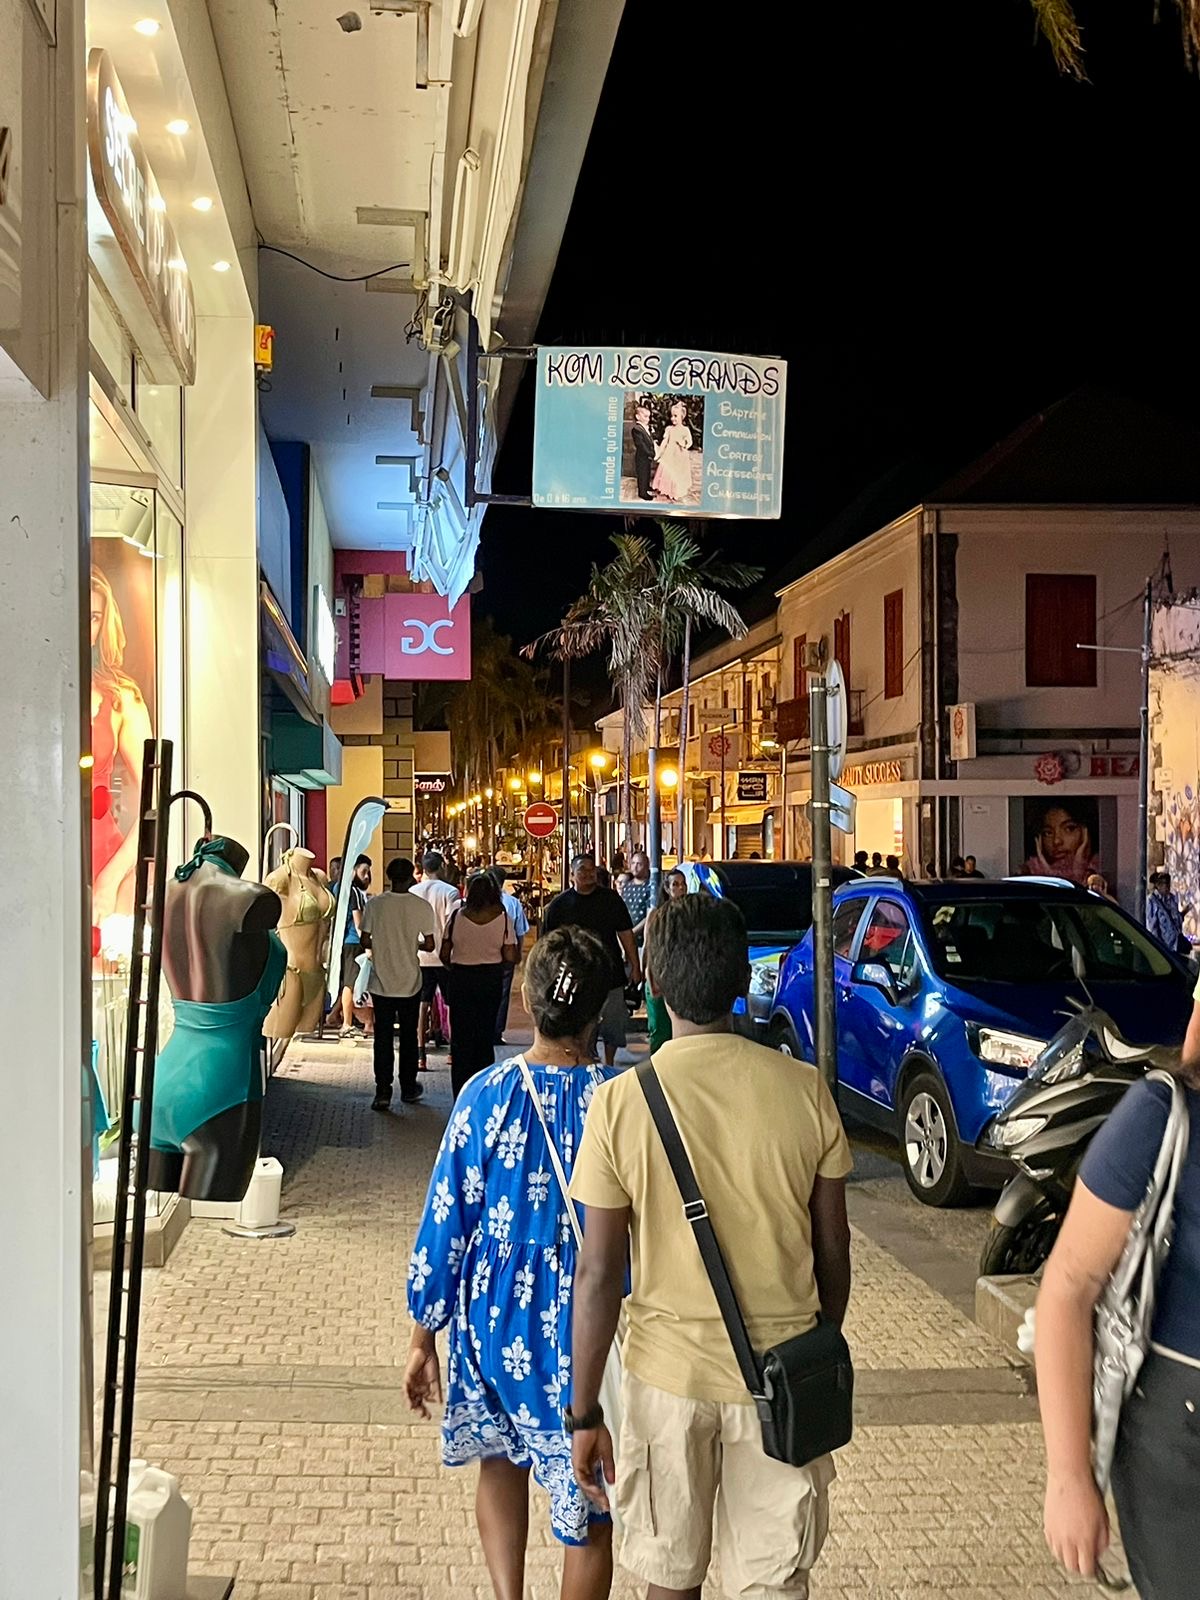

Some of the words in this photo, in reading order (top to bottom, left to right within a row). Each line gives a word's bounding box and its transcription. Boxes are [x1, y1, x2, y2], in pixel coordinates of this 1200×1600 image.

[547, 353, 603, 385] KOM
[610, 353, 661, 386] LES
[668, 357, 780, 396] GRANDS
[607, 396, 619, 422] aime
[601, 424, 619, 453] qu'on
[601, 456, 617, 484] mode
[600, 487, 615, 500] La
[865, 760, 901, 784] SUCCESS
